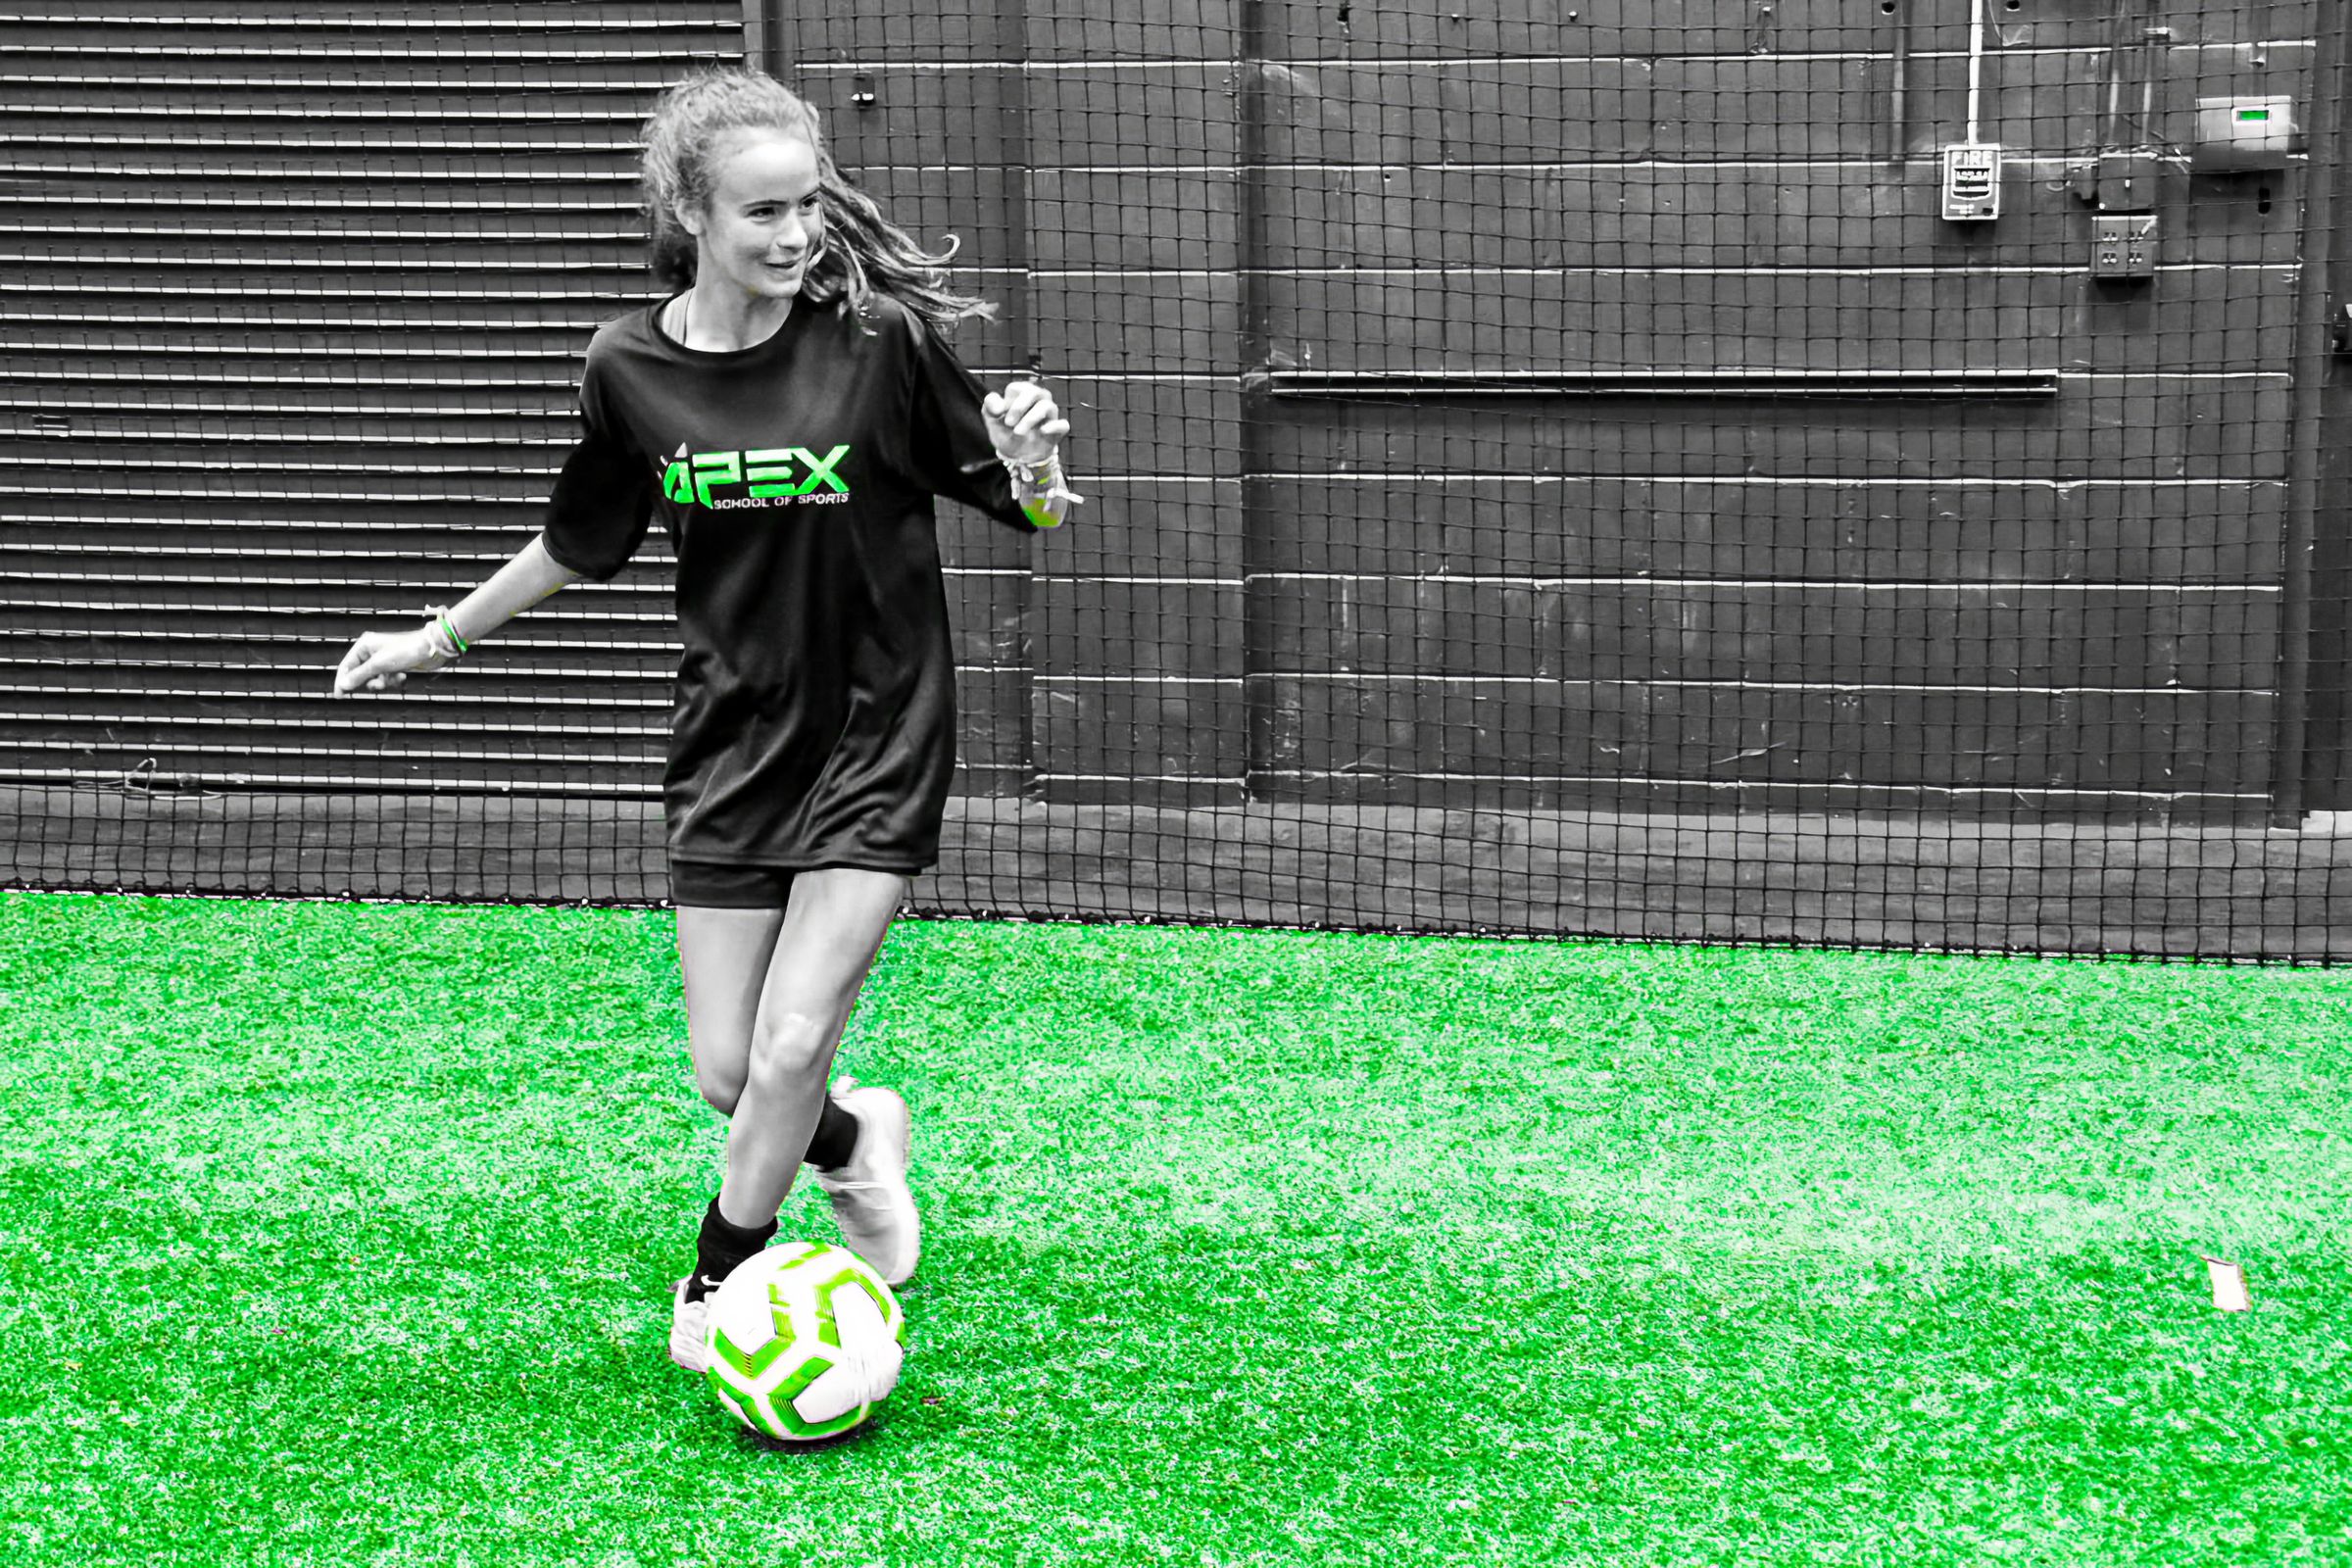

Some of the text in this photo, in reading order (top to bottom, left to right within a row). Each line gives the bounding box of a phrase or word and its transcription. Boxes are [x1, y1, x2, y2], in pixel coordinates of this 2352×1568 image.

[1951, 150, 1993, 166] FIRE
[662, 442, 850, 510] APEX
[713, 492, 850, 510] SCHOOL OF SPORTS
